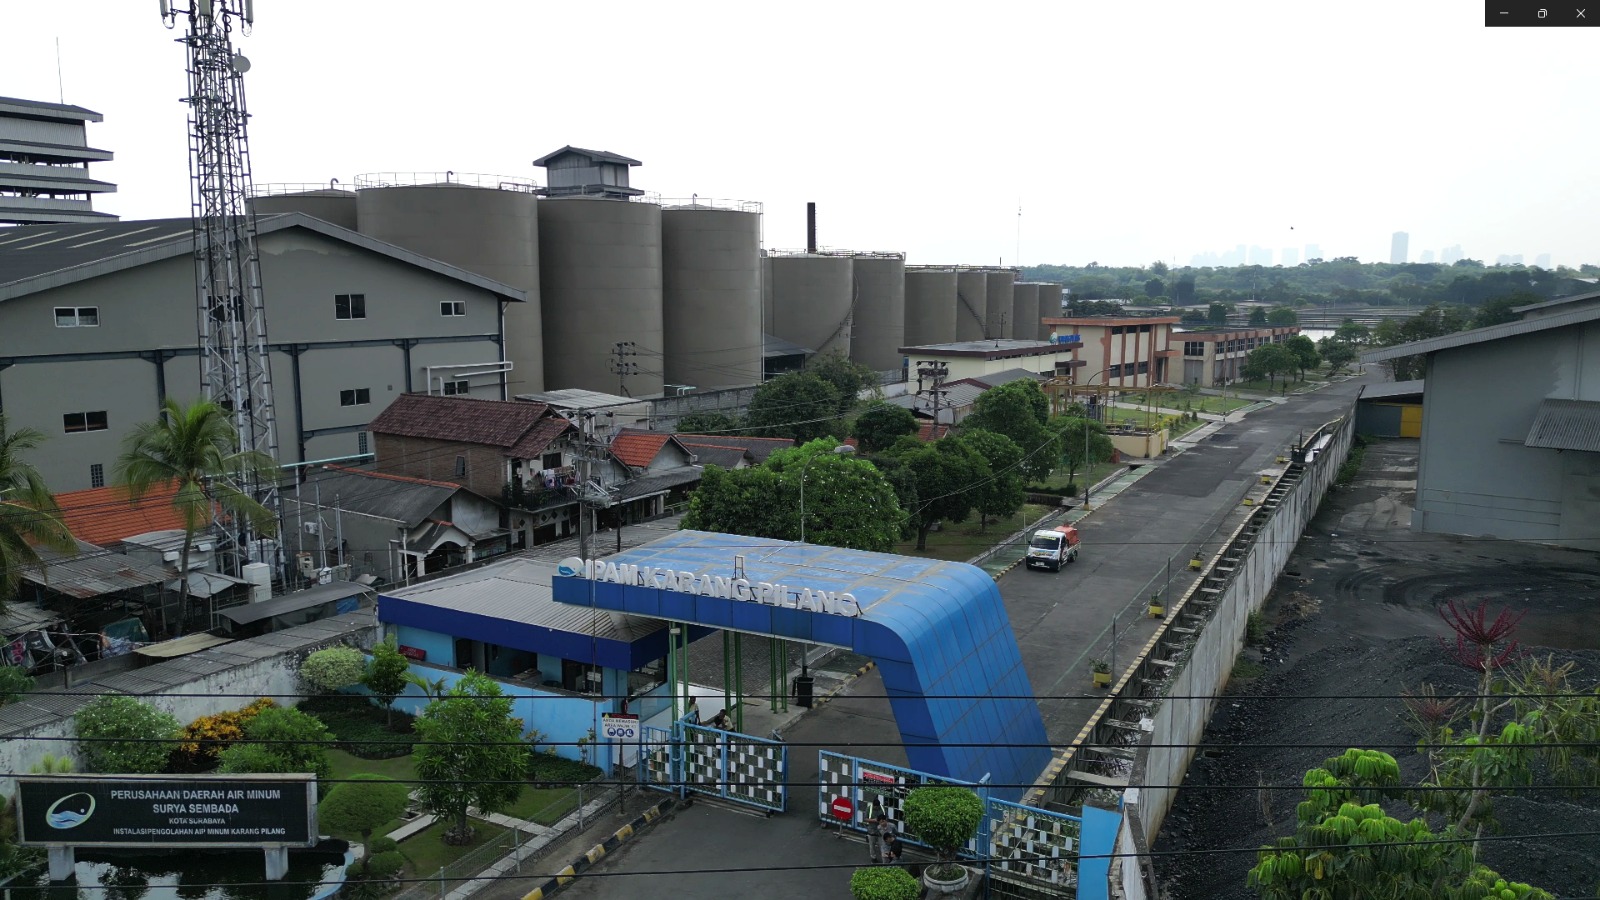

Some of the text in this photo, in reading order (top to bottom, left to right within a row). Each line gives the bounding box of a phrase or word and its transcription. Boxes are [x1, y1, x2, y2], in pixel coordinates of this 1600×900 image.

[585, 559, 859, 617] IPAM KARANG PILANG
[110, 789, 281, 800] PERUSAHAAN DAERAH AIR MINUM
[152, 803, 239, 813] SURYA SEMBADA
